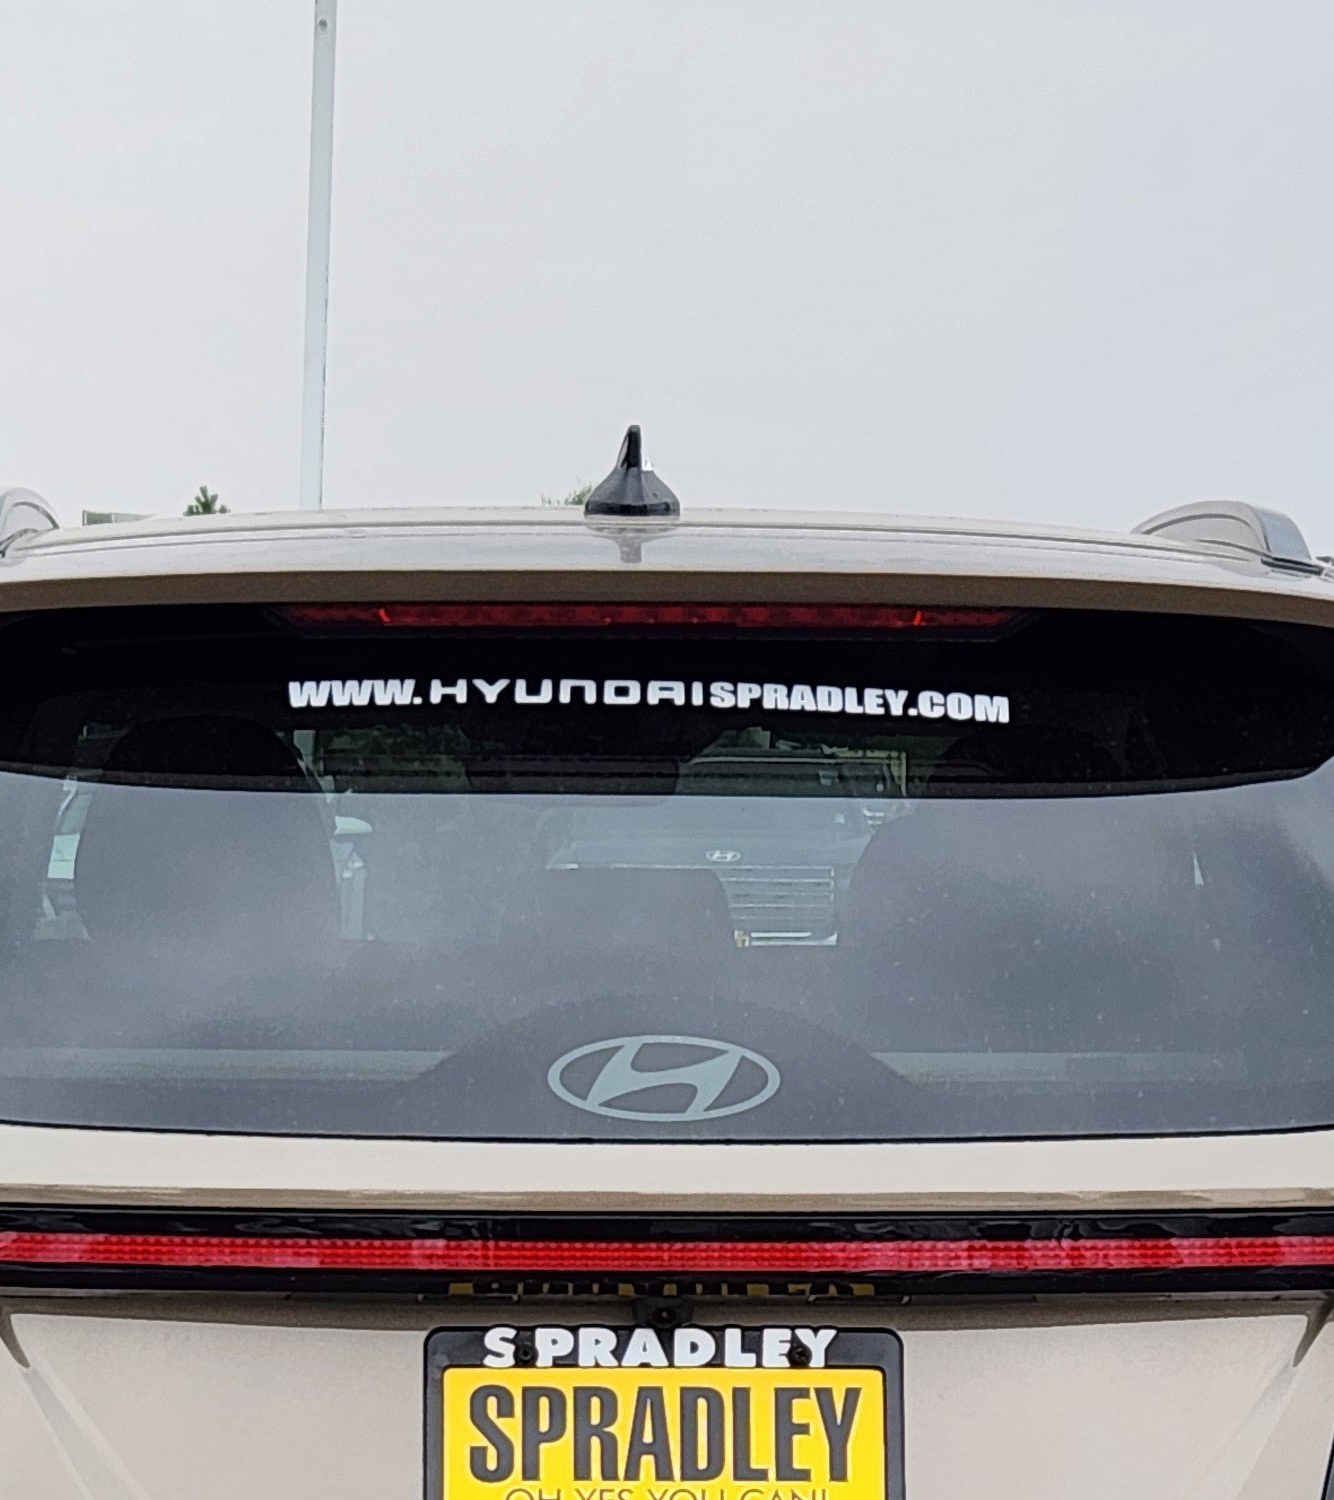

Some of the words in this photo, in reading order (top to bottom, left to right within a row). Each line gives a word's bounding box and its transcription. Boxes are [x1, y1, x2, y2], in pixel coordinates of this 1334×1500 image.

[288, 679, 1010, 723] WWW.HYUNDAISPRADLEY.COM
[483, 1327, 837, 1368] SPRADLEY
[469, 1385, 862, 1482] SPRADLEY
